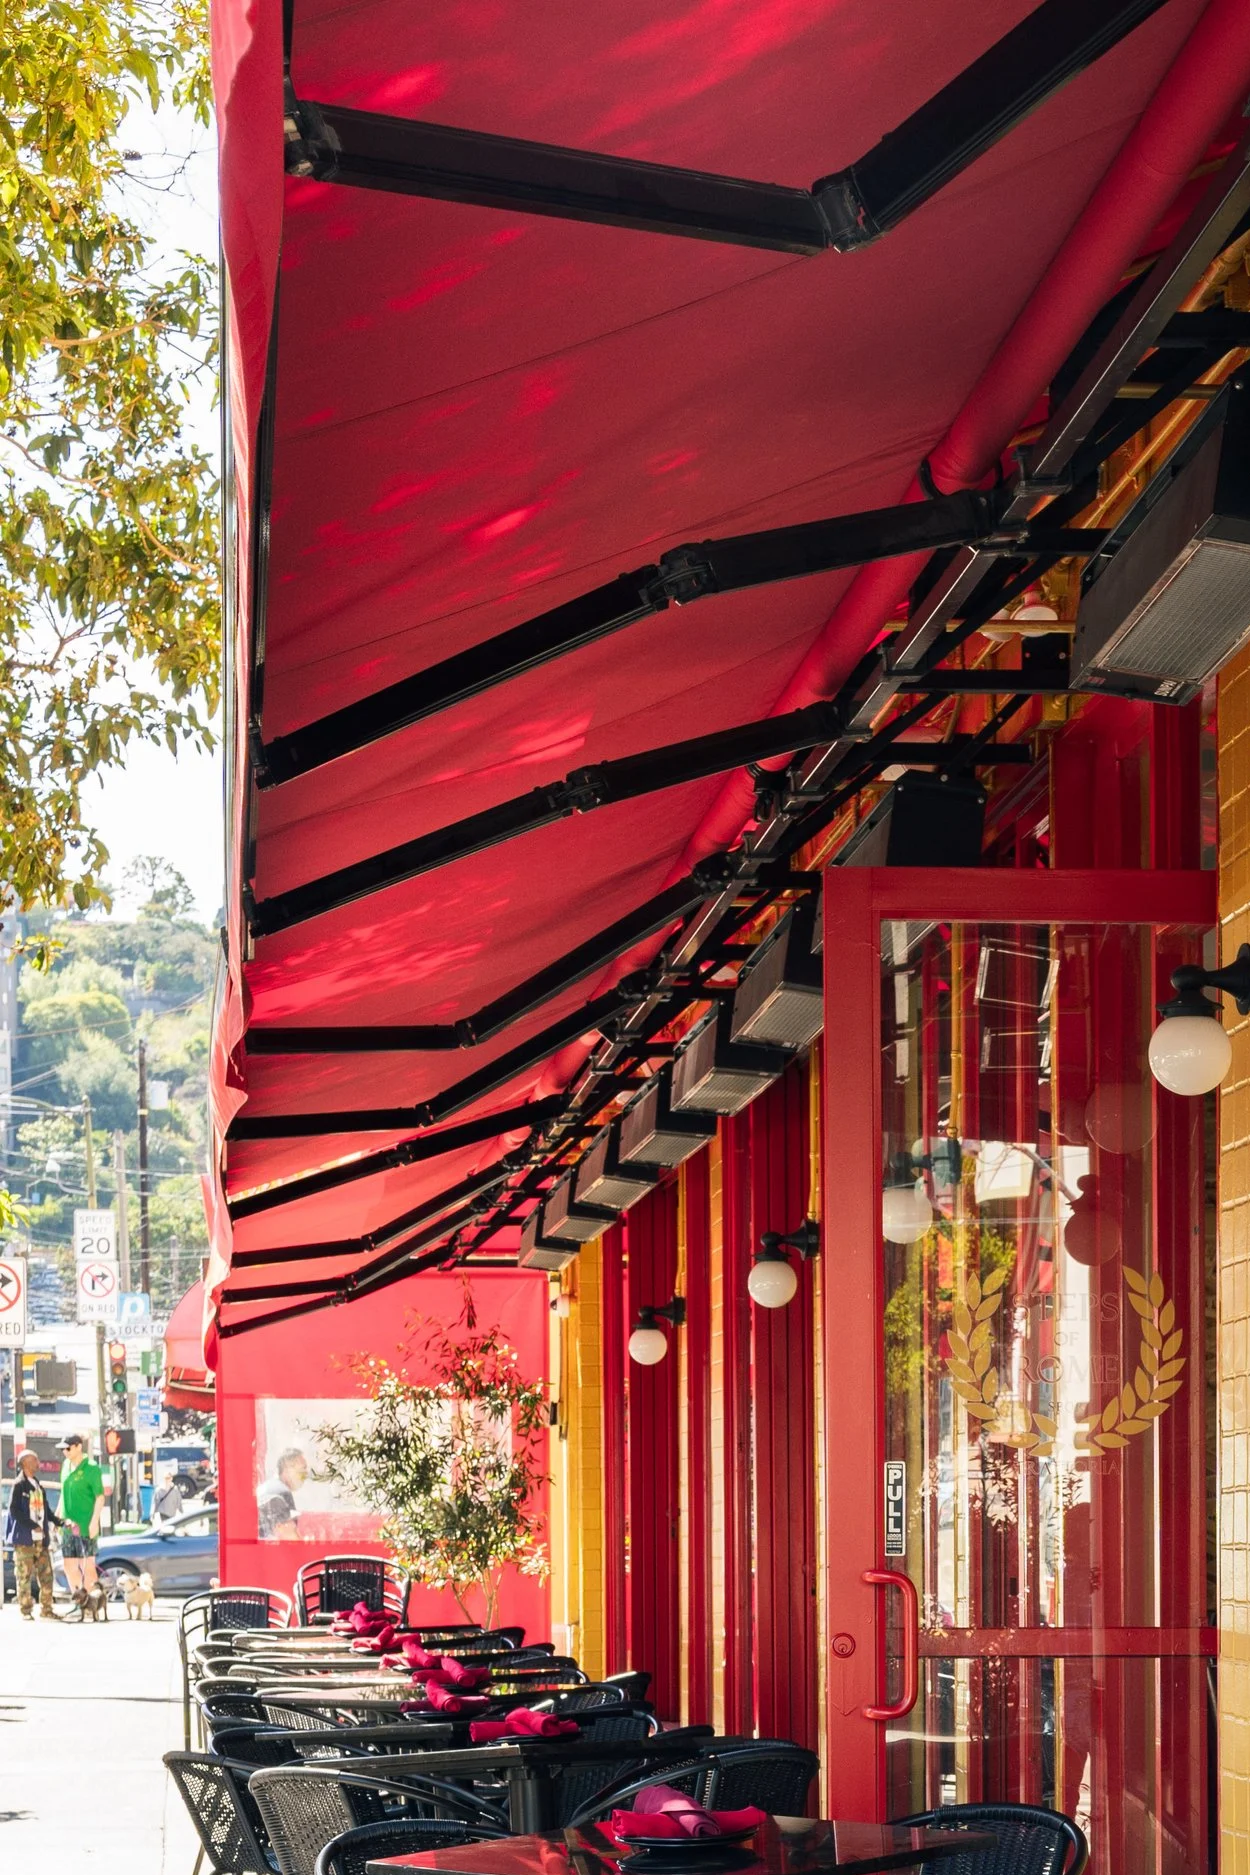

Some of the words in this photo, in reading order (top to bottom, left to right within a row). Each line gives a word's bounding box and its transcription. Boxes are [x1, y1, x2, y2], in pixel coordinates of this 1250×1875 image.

[79, 1215, 112, 1225] SPEED
[81, 1237, 111, 1254] 20
[82, 1303, 94, 1313] ON
[97, 1303, 116, 1313] RED
[1012, 1292, 1120, 1322] STEPS
[1053, 1331, 1080, 1347] OF
[1018, 1354, 1121, 1385] ROME
[887, 1469, 902, 1533] PULL
